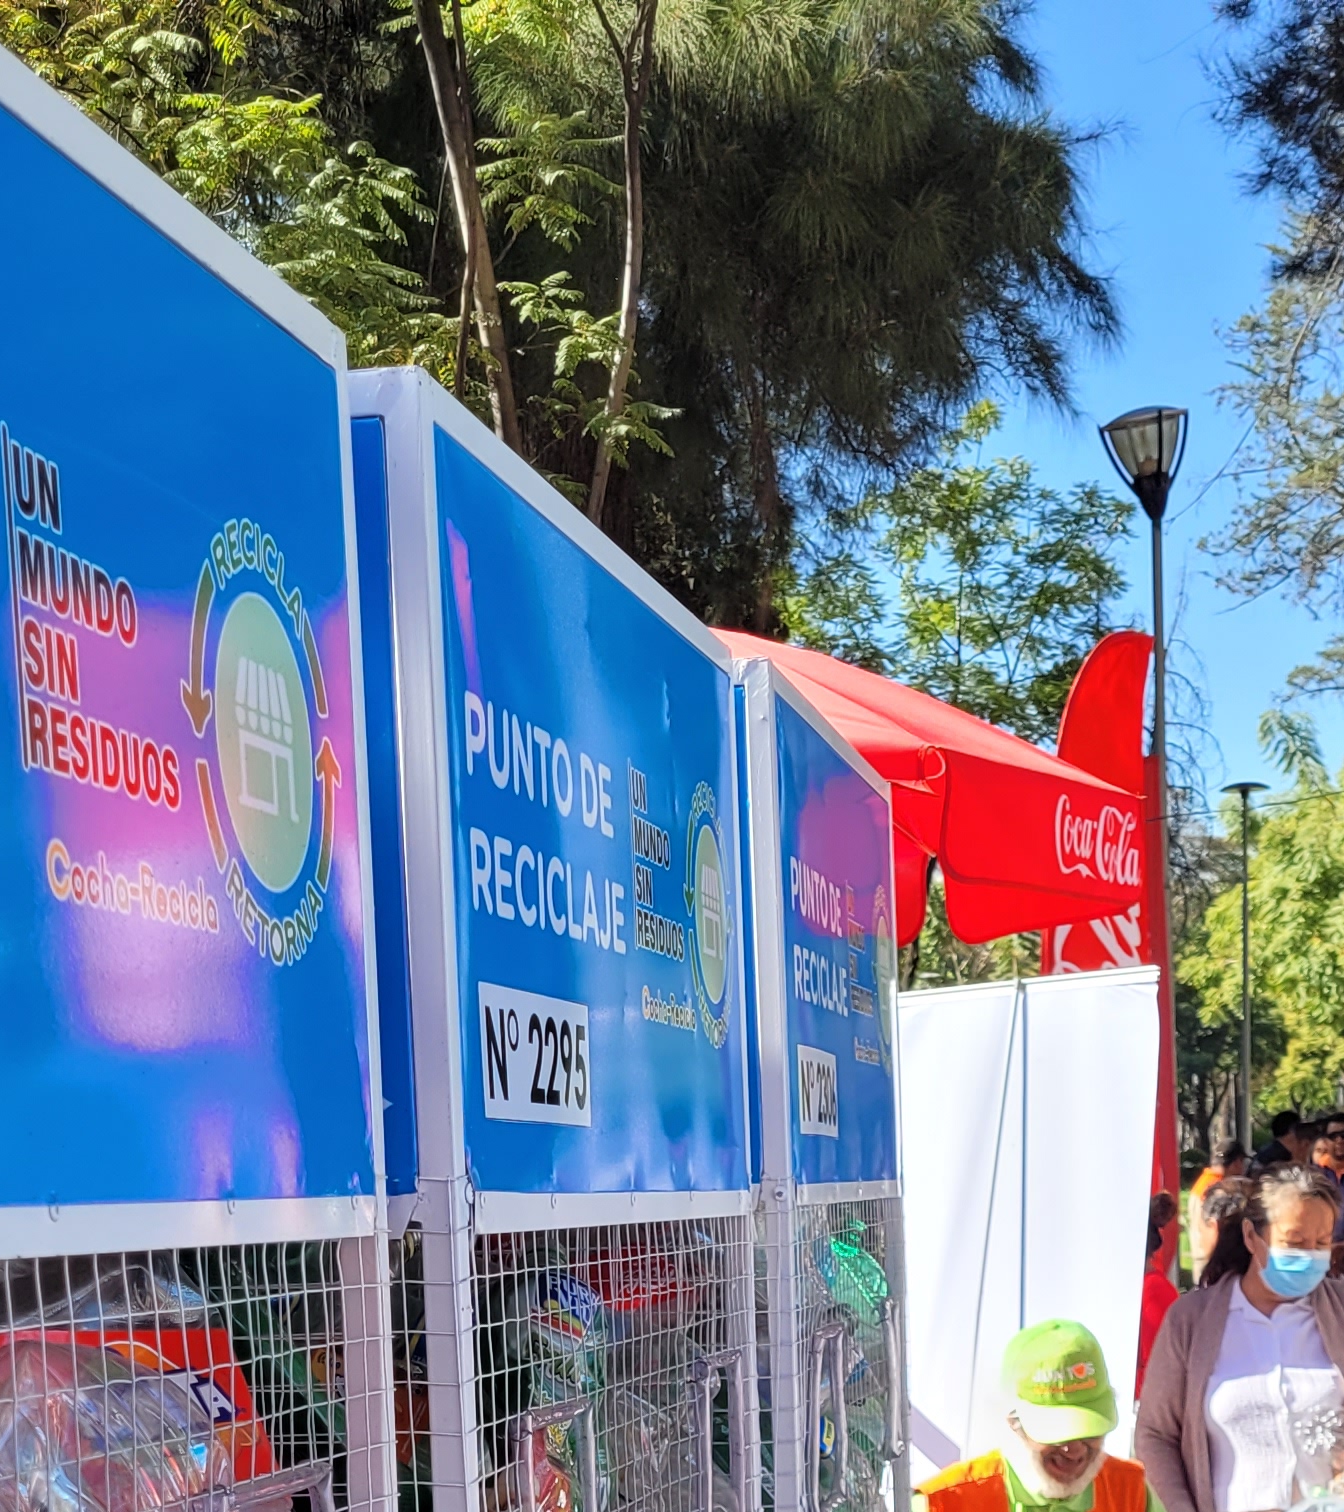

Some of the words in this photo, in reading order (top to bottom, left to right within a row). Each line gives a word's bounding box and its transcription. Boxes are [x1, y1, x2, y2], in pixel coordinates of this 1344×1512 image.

[12, 442, 62, 534] UN
[18, 529, 137, 648] MUNDO
[210, 517, 304, 641] RECICLA
[23, 616, 80, 703] SIN
[26, 700, 182, 812] RESIDUOS
[463, 690, 572, 818] PUNTO
[579, 751, 615, 839] DE
[631, 766, 647, 813] UN
[46, 838, 219, 934] Cocha-Recicla
[632, 814, 671, 871] MUNDO
[635, 862, 653, 908] SIN
[1056, 793, 1141, 887] Coca-Cola
[225, 859, 323, 967] RETORNA
[469, 826, 627, 956] RECICLAJE
[635, 907, 685, 963] RESIDUOS
[790, 856, 829, 929] PUNTO
[829, 882, 843, 938] DE
[793, 944, 849, 1018] RECICLAJE
[528, 1012, 588, 1111] 2295
